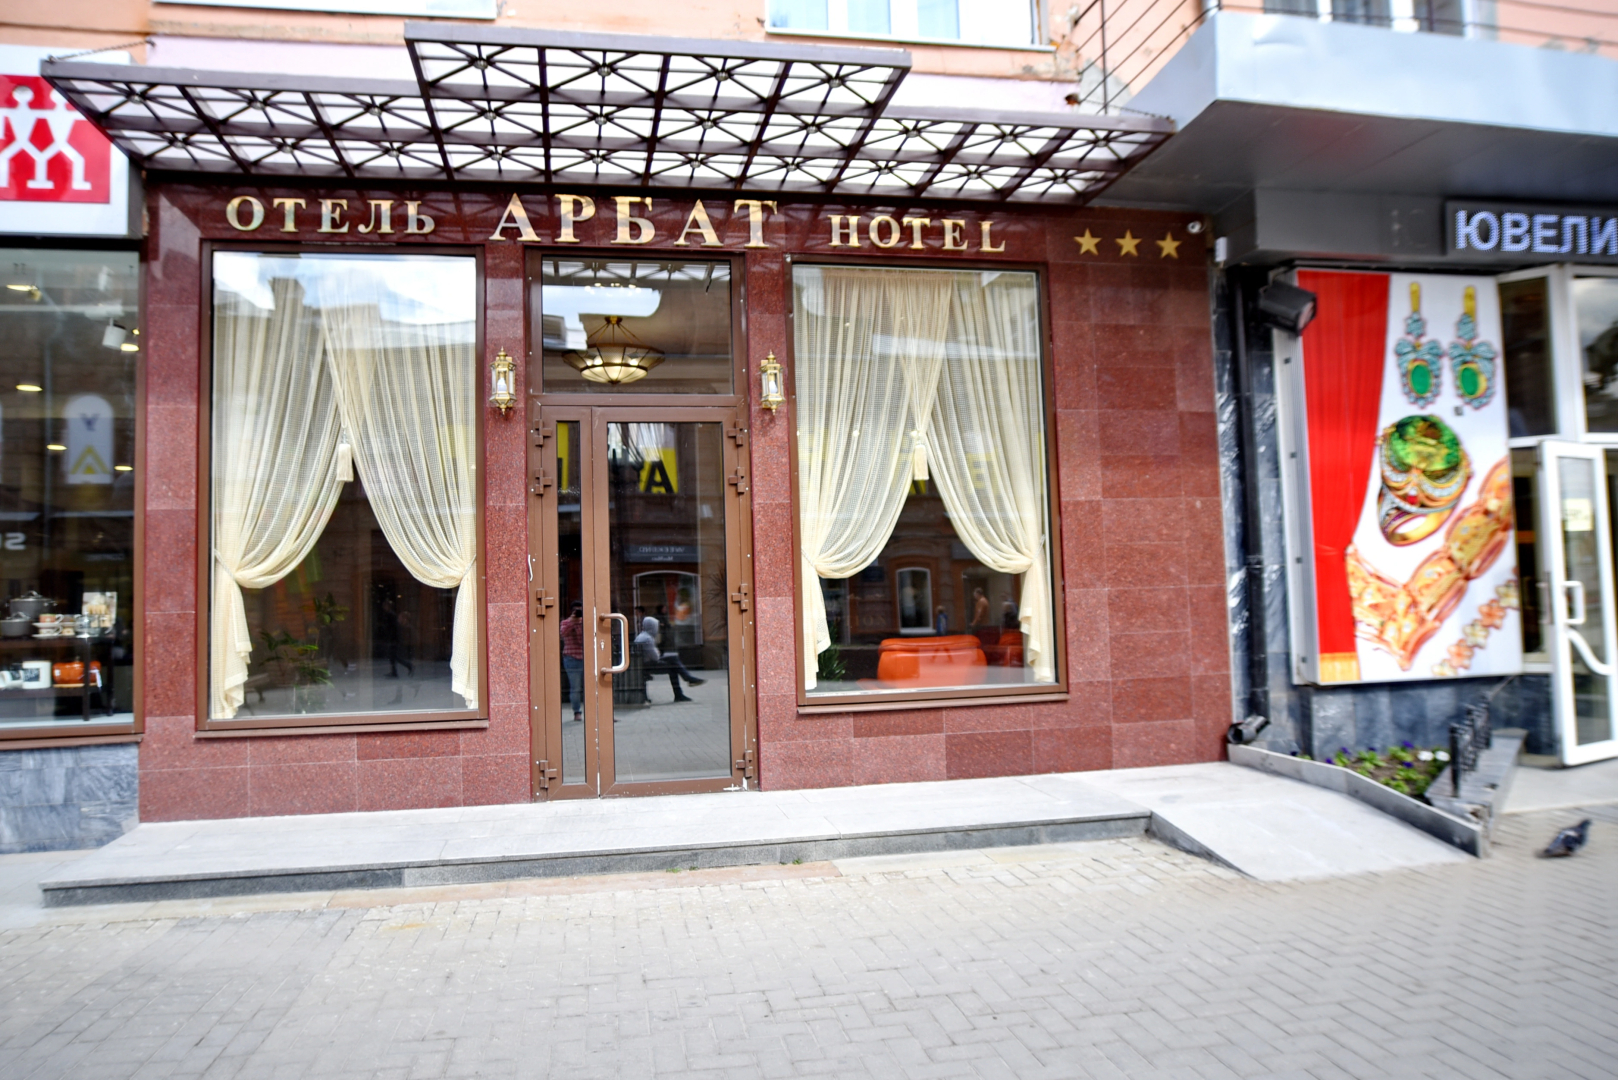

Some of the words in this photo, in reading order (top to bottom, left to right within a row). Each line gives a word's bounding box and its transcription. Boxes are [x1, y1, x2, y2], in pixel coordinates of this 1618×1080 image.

[226, 195, 436, 235] ОТЕЛЬ
[488, 192, 778, 249] АРБАТ
[828, 213, 1006, 253] HOTEL
[1455, 209, 1618, 256] ЮВЕЛИ
